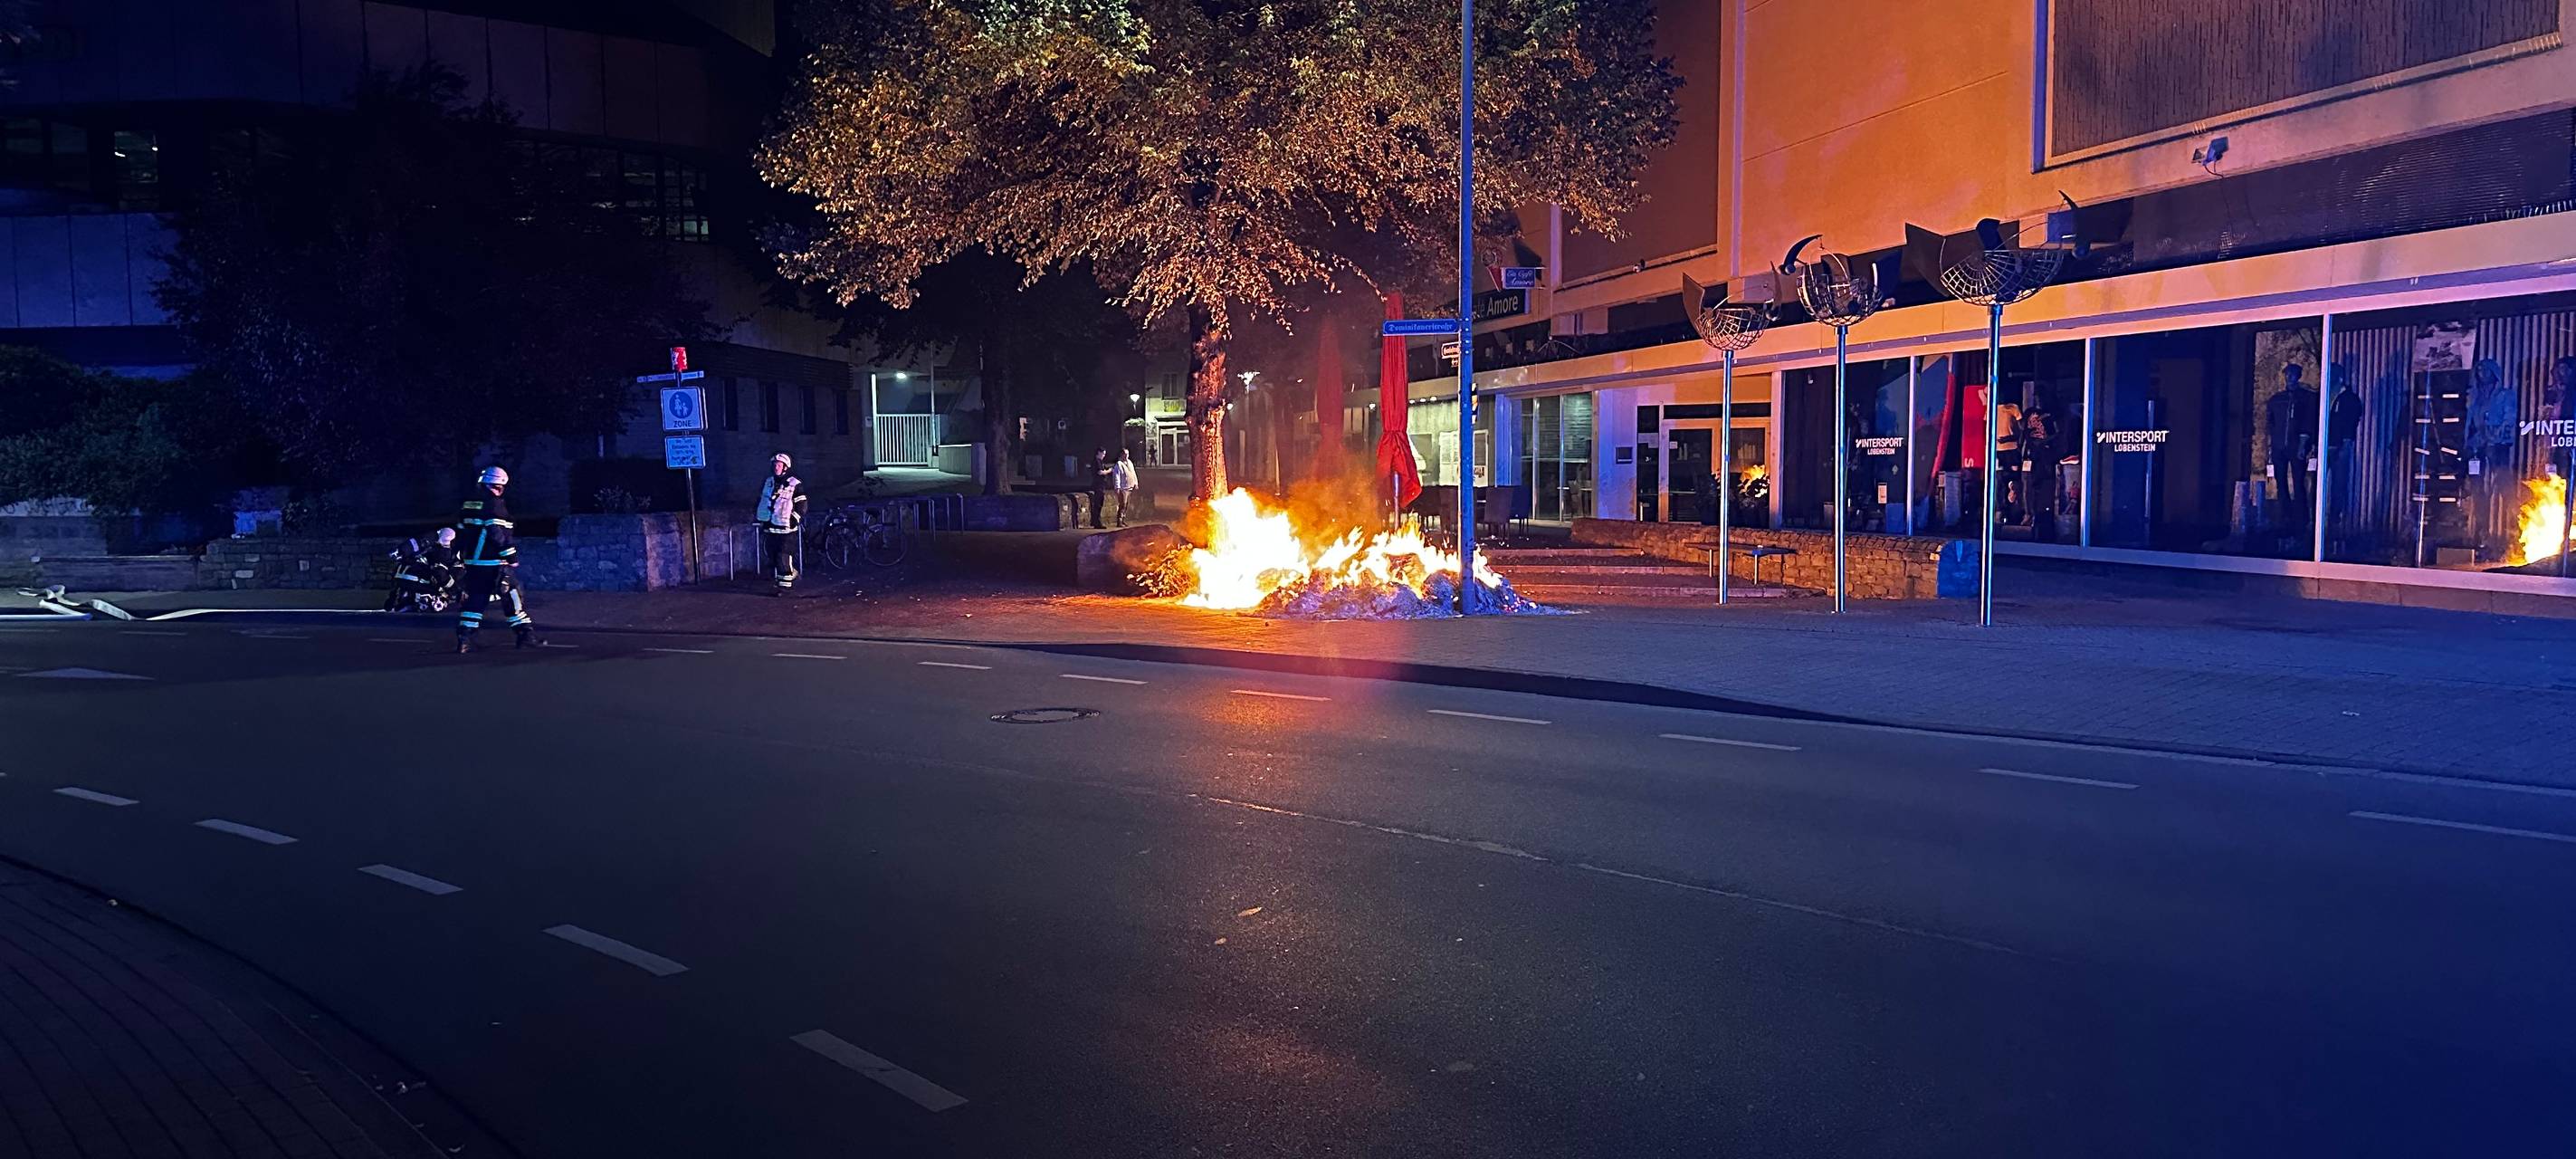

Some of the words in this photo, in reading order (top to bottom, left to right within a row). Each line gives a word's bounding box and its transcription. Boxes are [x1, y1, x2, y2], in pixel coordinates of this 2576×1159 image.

[1486, 295, 1518, 316] Amore
[2535, 420, 2576, 435] INTE
[1861, 437, 1904, 447] INTERSPORT
[2105, 430, 2170, 443] INTERSPORT
[2113, 444, 2156, 452] LOBENSTEIN
